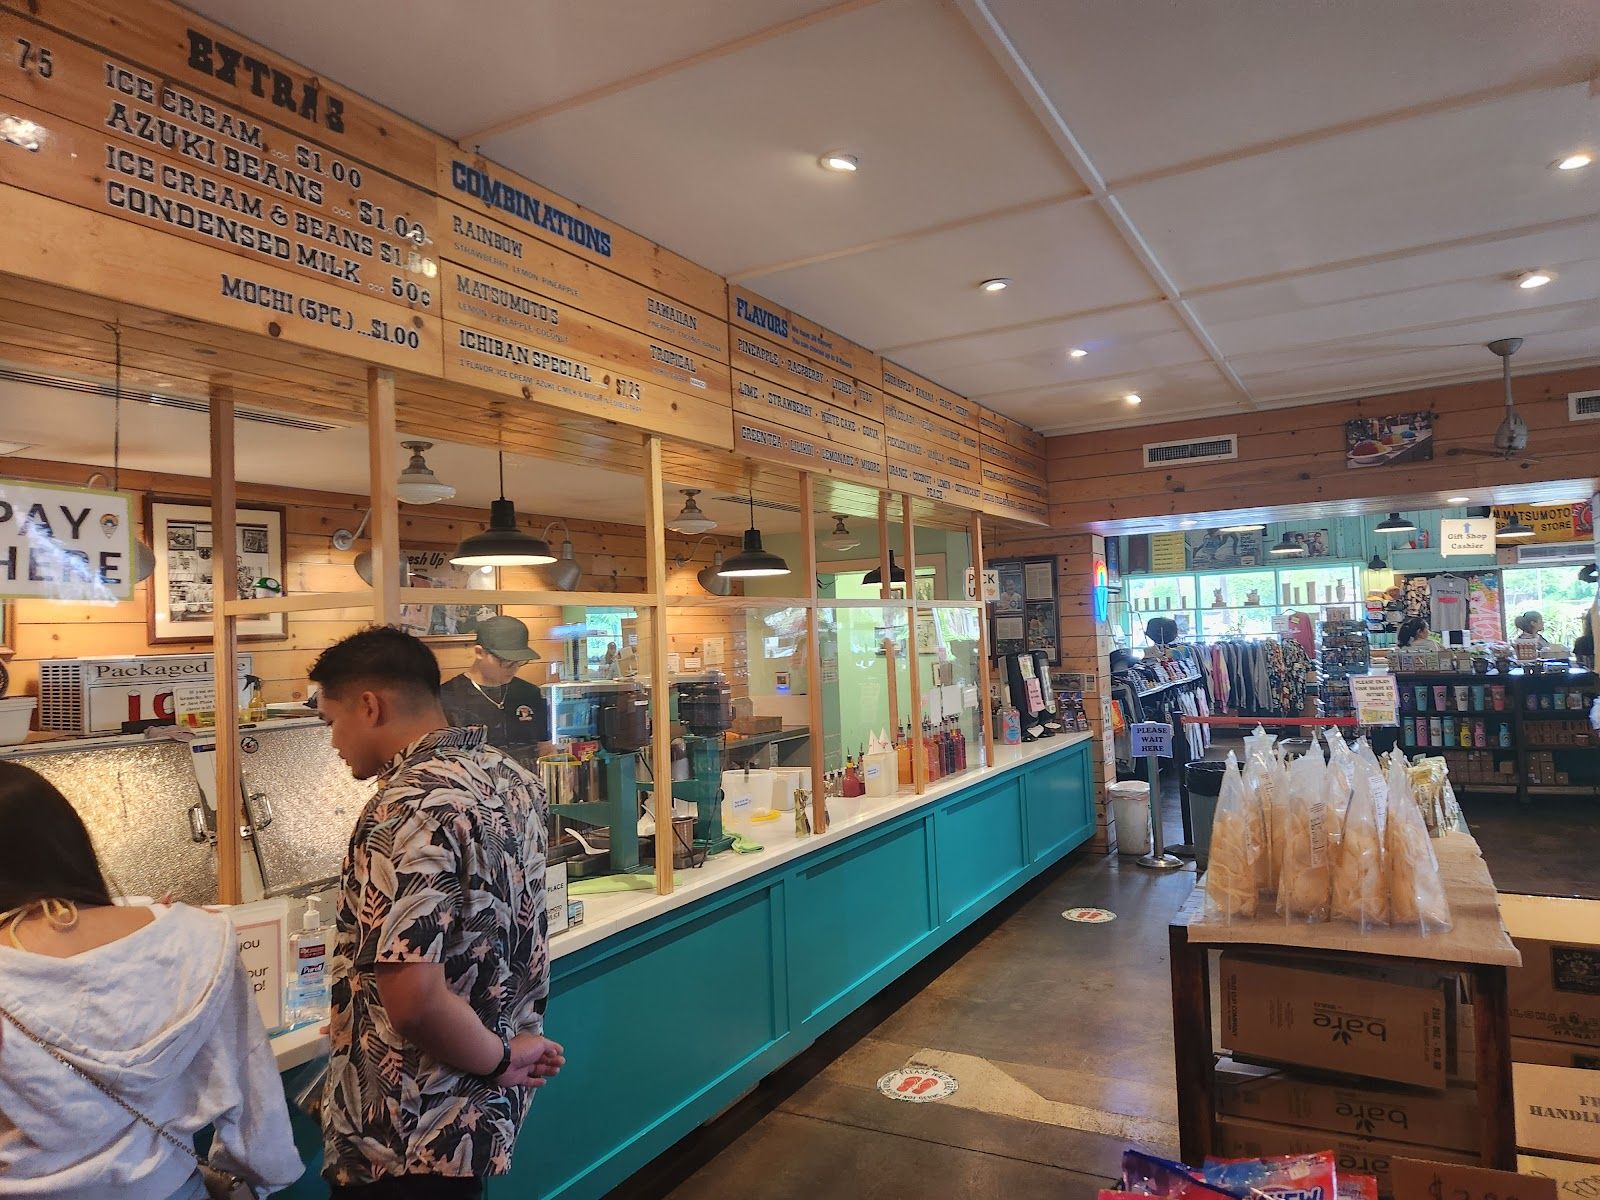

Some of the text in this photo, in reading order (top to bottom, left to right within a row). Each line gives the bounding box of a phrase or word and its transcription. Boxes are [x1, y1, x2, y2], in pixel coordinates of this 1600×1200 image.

[106, 63, 362, 191] ICE CREAM $1.00
[106, 100, 216, 164] AZUKI
[224, 144, 324, 207] BEANS
[106, 145, 154, 183] ICE
[162, 164, 262, 220] CREAM
[270, 204, 287, 226] &
[294, 212, 373, 259] BEANS
[452, 160, 612, 258] COMBINATIONS
[106, 179, 291, 262] CONDENSED
[296, 243, 361, 286] MILK
[453, 215, 523, 259] RAINBOW
[220, 273, 294, 315] MOCHI
[736, 297, 788, 338] FLAVORS
[459, 329, 529, 364] ICHIBAN
[532, 350, 592, 383] SPECIAL
[650, 344, 697, 373] TROPICAL
[738, 338, 780, 368] PINEAPPLE
[787, 359, 824, 383] RASPBERRY
[739, 382, 758, 399] LIME
[768, 393, 813, 417] STRAWBERRY
[1448, 532, 1488, 541] Gift Shop
[1542, 521, 1572, 531] STORE
[96, 660, 208, 682] Packaged
[1313, 1011, 1387, 1042] bare
[1335, 1102, 1408, 1130] bare
